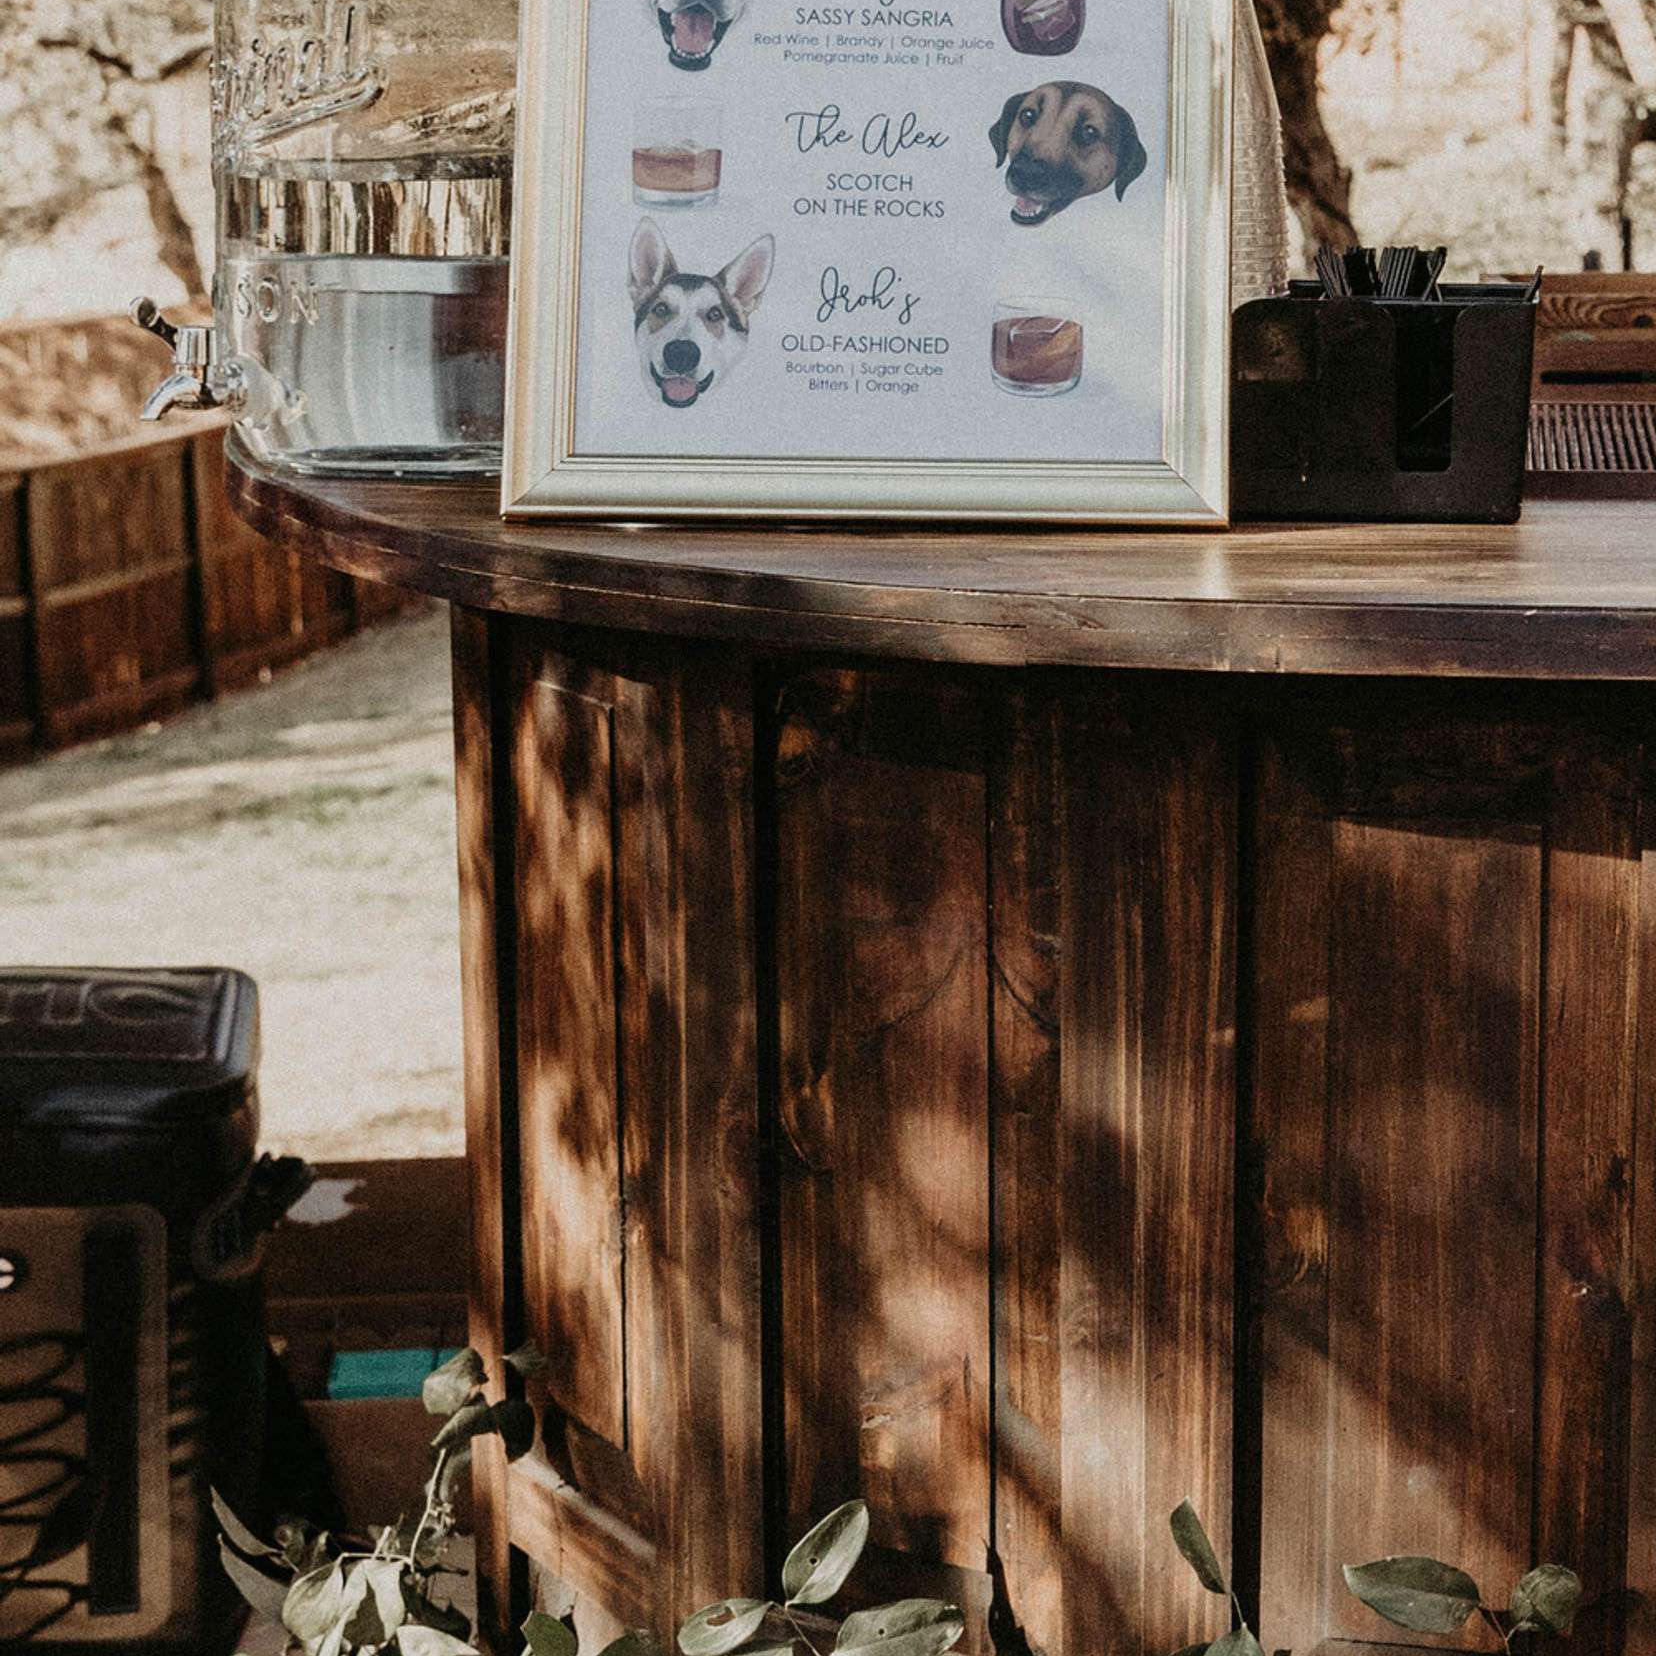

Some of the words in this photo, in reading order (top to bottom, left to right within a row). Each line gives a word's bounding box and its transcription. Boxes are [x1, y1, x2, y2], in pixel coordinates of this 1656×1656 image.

[795, 7, 855, 26] SASSY
[860, 8, 954, 28] SANGRIA
[754, 33, 781, 46] Red
[785, 33, 820, 47] Wine
[836, 34, 884, 49] Brandy
[901, 35, 955, 51] Orange
[958, 36, 995, 51] Juice
[783, 49, 879, 66] Pomegranate
[882, 51, 920, 65] Juice
[936, 51, 964, 66] Fruit
[785, 104, 854, 153] The
[862, 111, 950, 159] Alex
[826, 172, 914, 192] SCOTCH
[792, 197, 827, 216] ON
[833, 198, 868, 217] THE
[874, 199, 946, 219] ROCKS
[781, 333, 950, 355] OLD-FASHIONED
[785, 361, 844, 374] Bourbon
[860, 362, 901, 378] Sugar
[903, 363, 944, 376] Cube
[808, 378, 849, 391] Bitters
[866, 379, 920, 395] Orange
